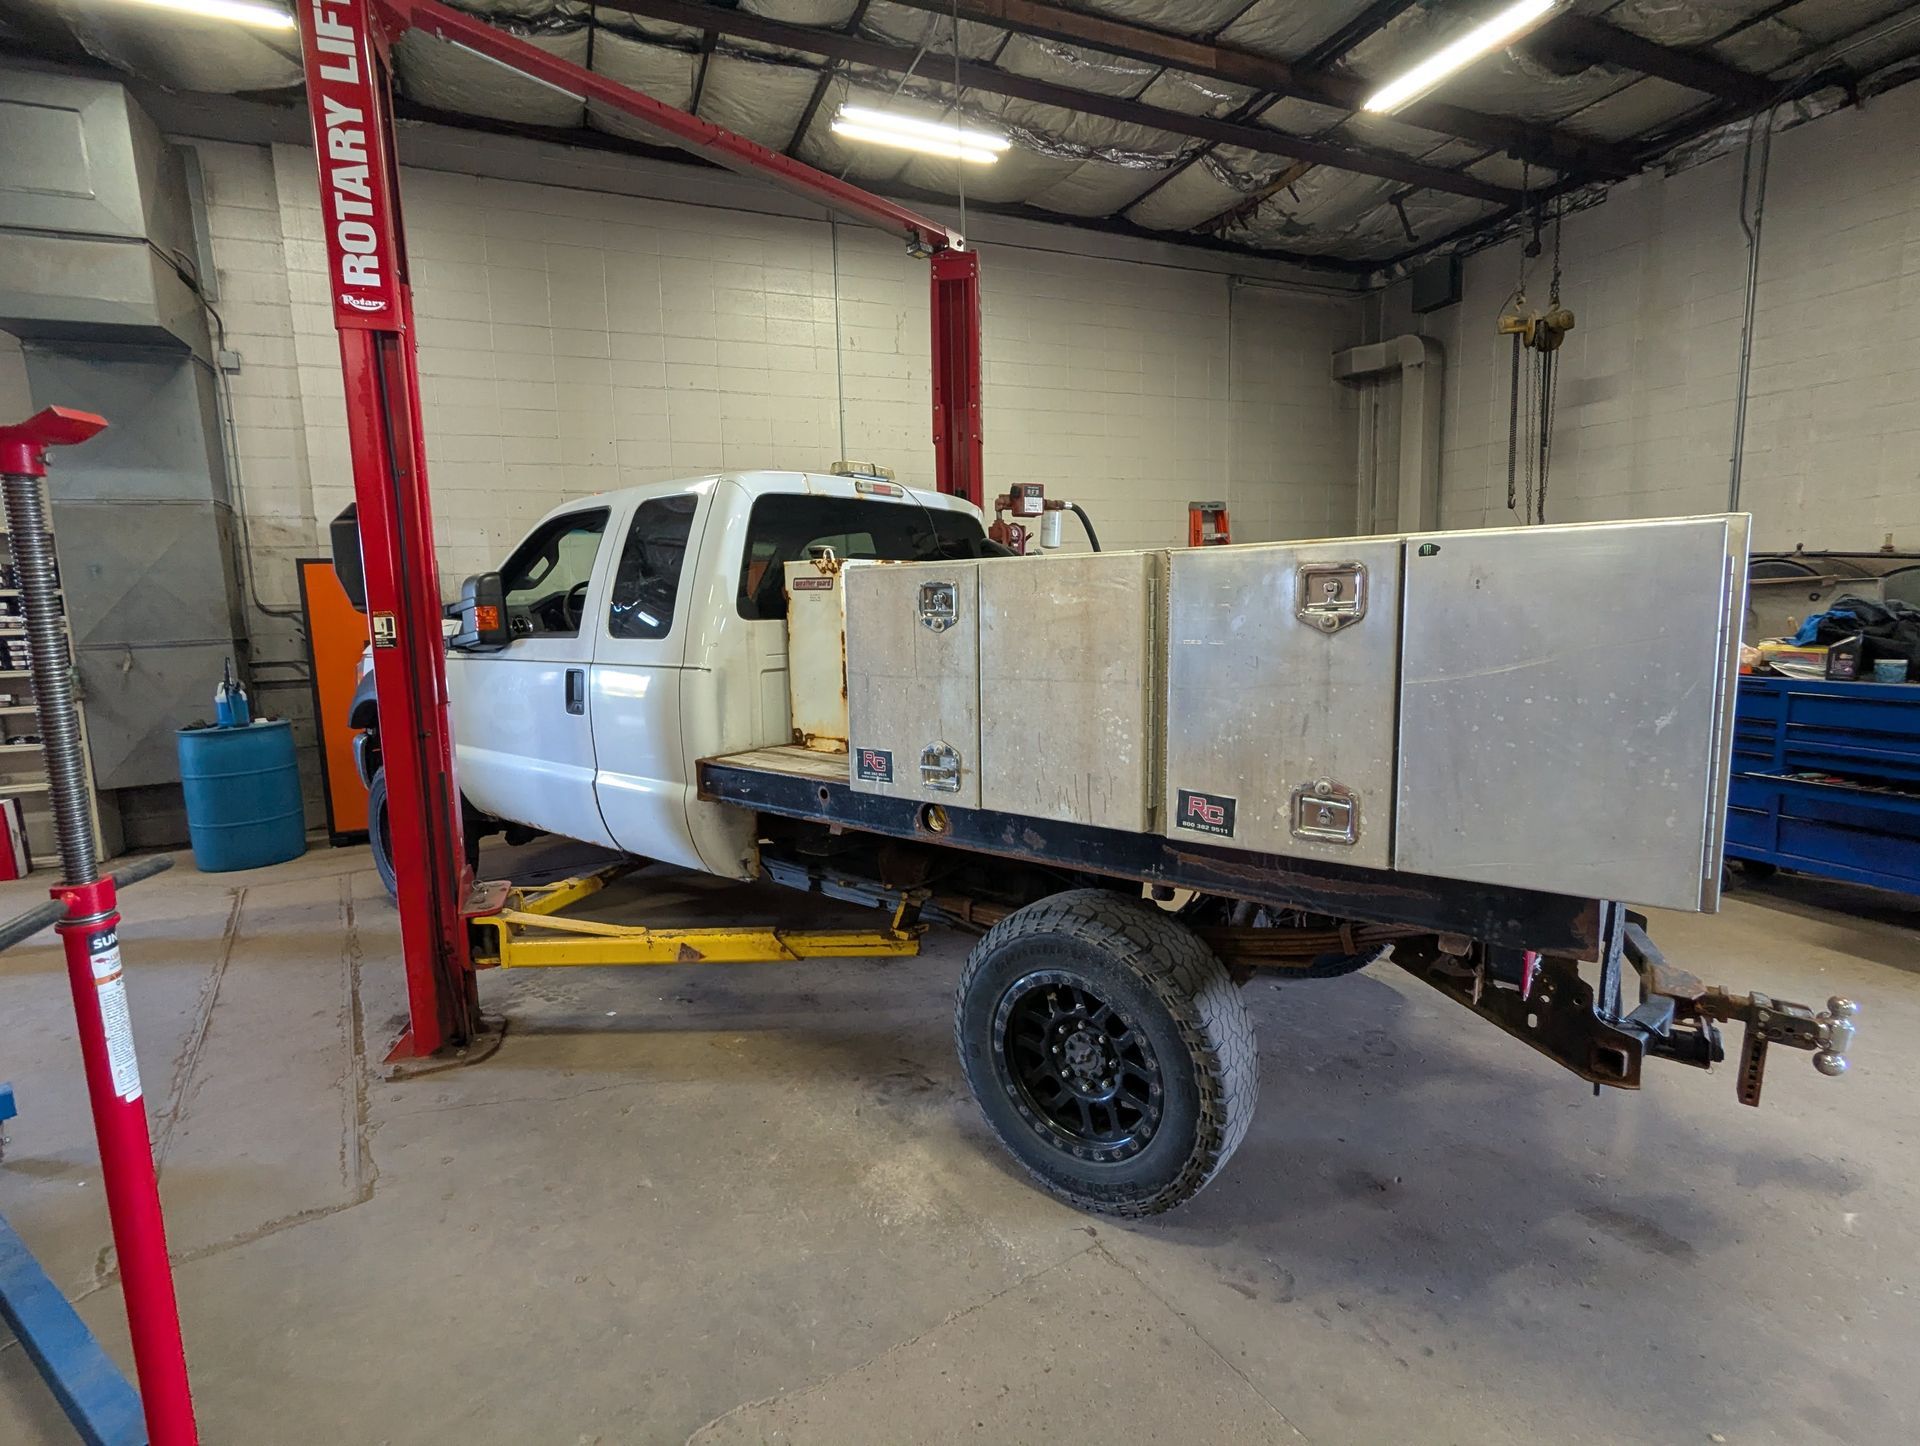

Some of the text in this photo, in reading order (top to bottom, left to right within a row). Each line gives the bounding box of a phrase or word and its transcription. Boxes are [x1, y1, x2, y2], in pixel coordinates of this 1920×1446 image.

[312, 0, 381, 287] ROTARY LIF
[341, 293, 386, 310] Rotary
